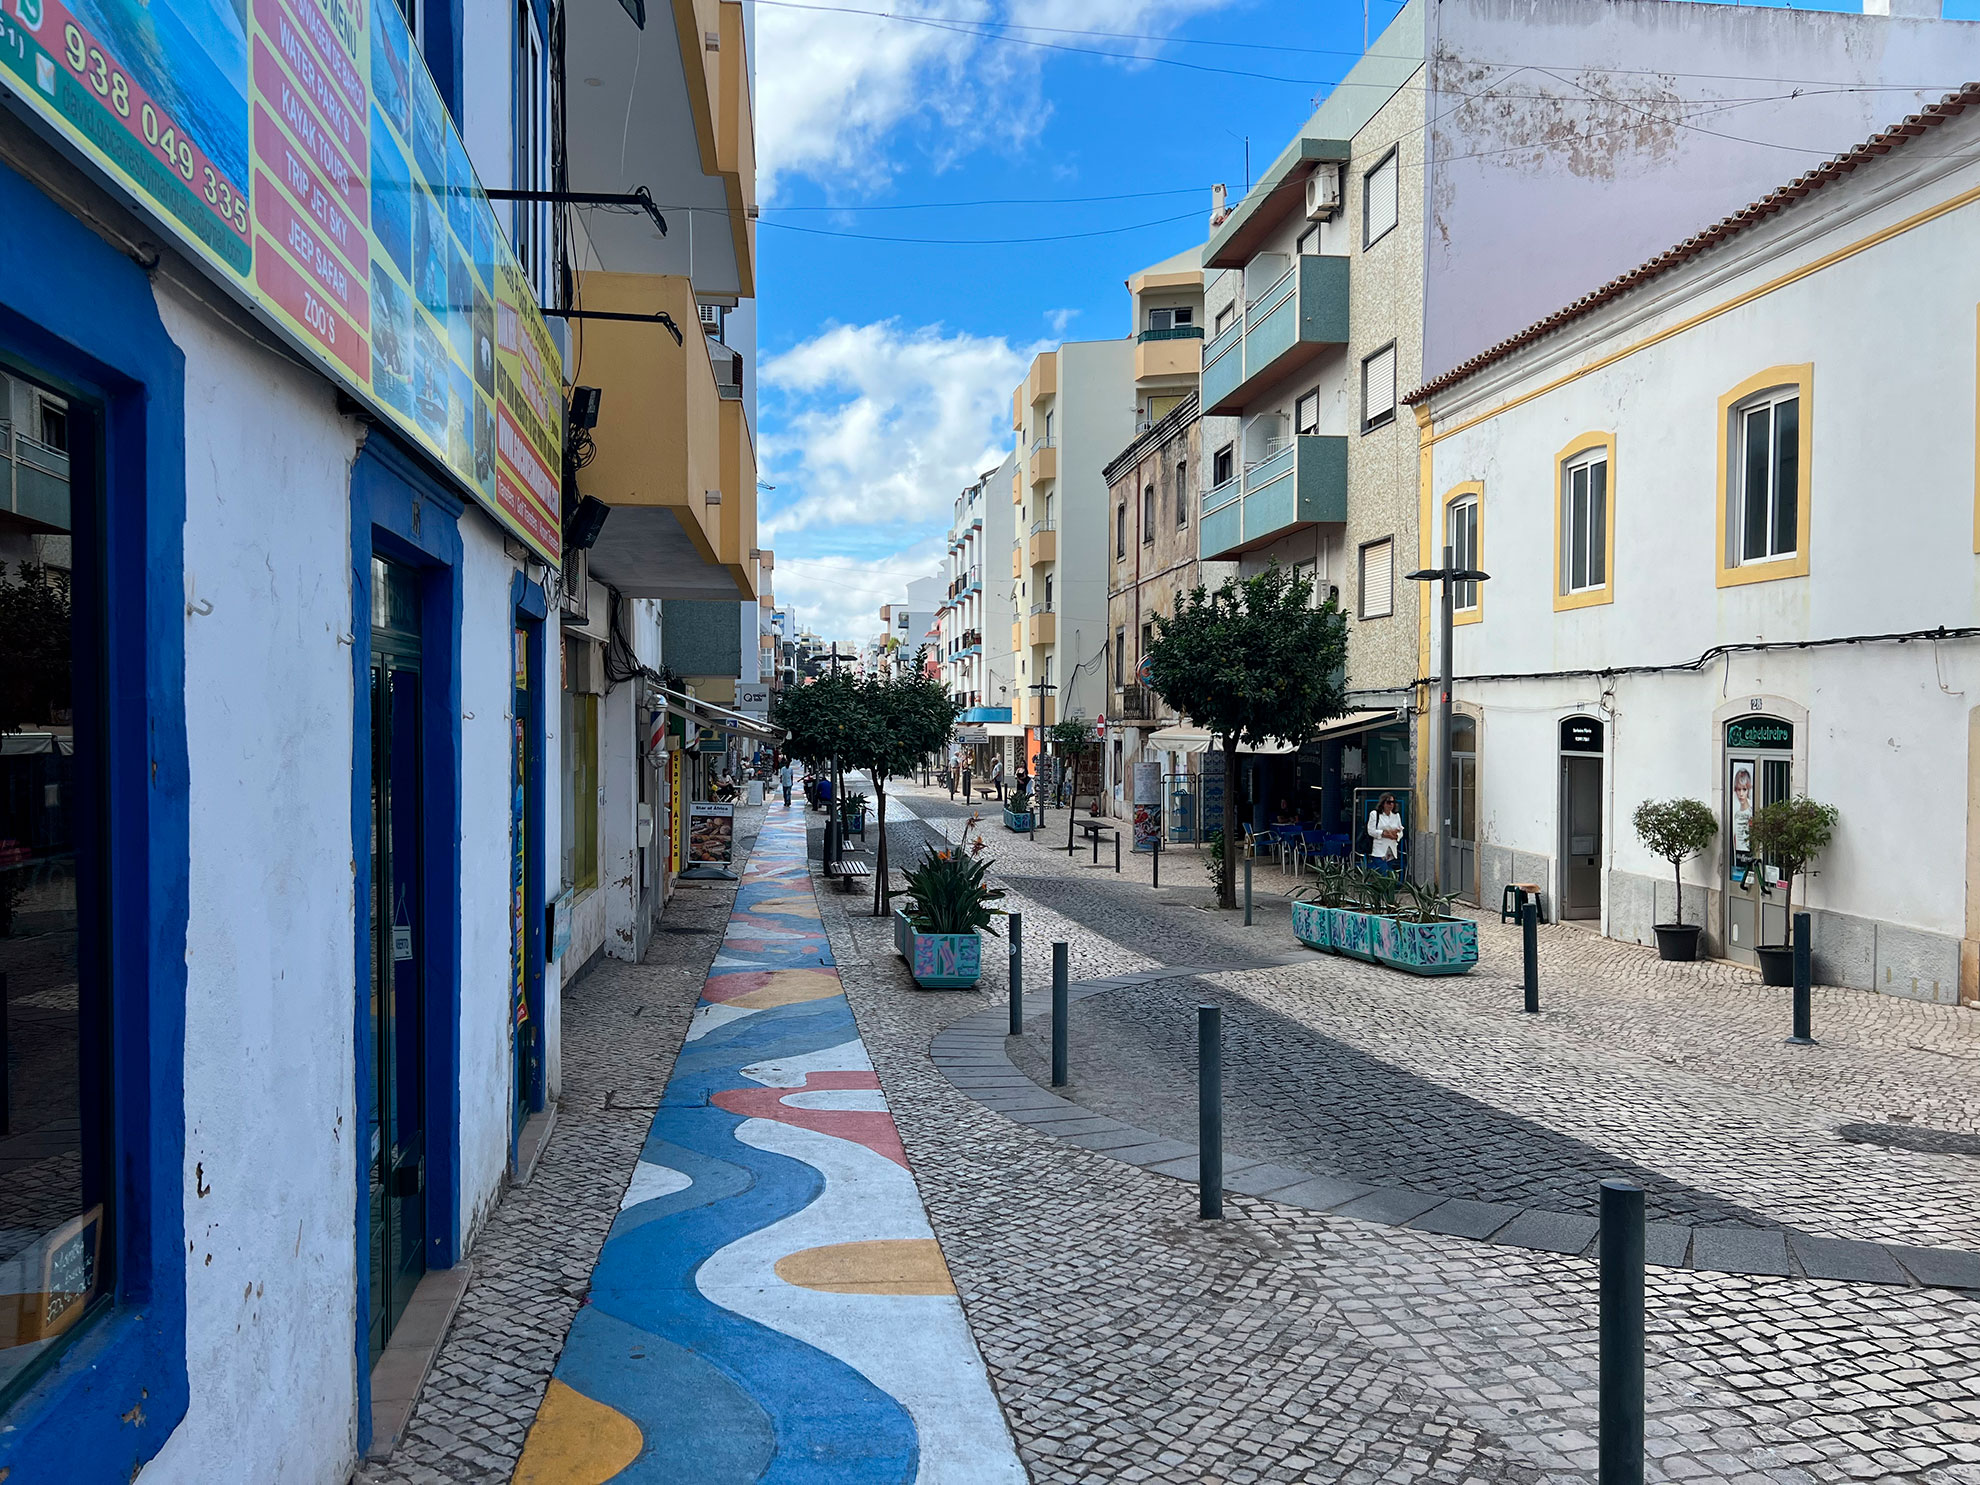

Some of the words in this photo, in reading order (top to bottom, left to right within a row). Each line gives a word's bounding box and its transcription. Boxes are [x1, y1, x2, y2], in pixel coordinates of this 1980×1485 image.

[280, 16, 316, 94] WATER
[330, 0, 356, 60] MENU
[64, 22, 130, 118] 938
[141, 103, 194, 182] 049
[203, 165, 248, 234] 335
[282, 82, 317, 154] KAYAK
[318, 134, 349, 196] TOURS
[286, 150, 309, 199] TRIP
[310, 185, 328, 226] JET
[330, 206, 348, 246] SKY
[288, 218, 314, 264] JEEP
[315, 246, 348, 302] SAFARI
[1751, 699, 1762, 710] 28
[673, 791, 679, 804] of
